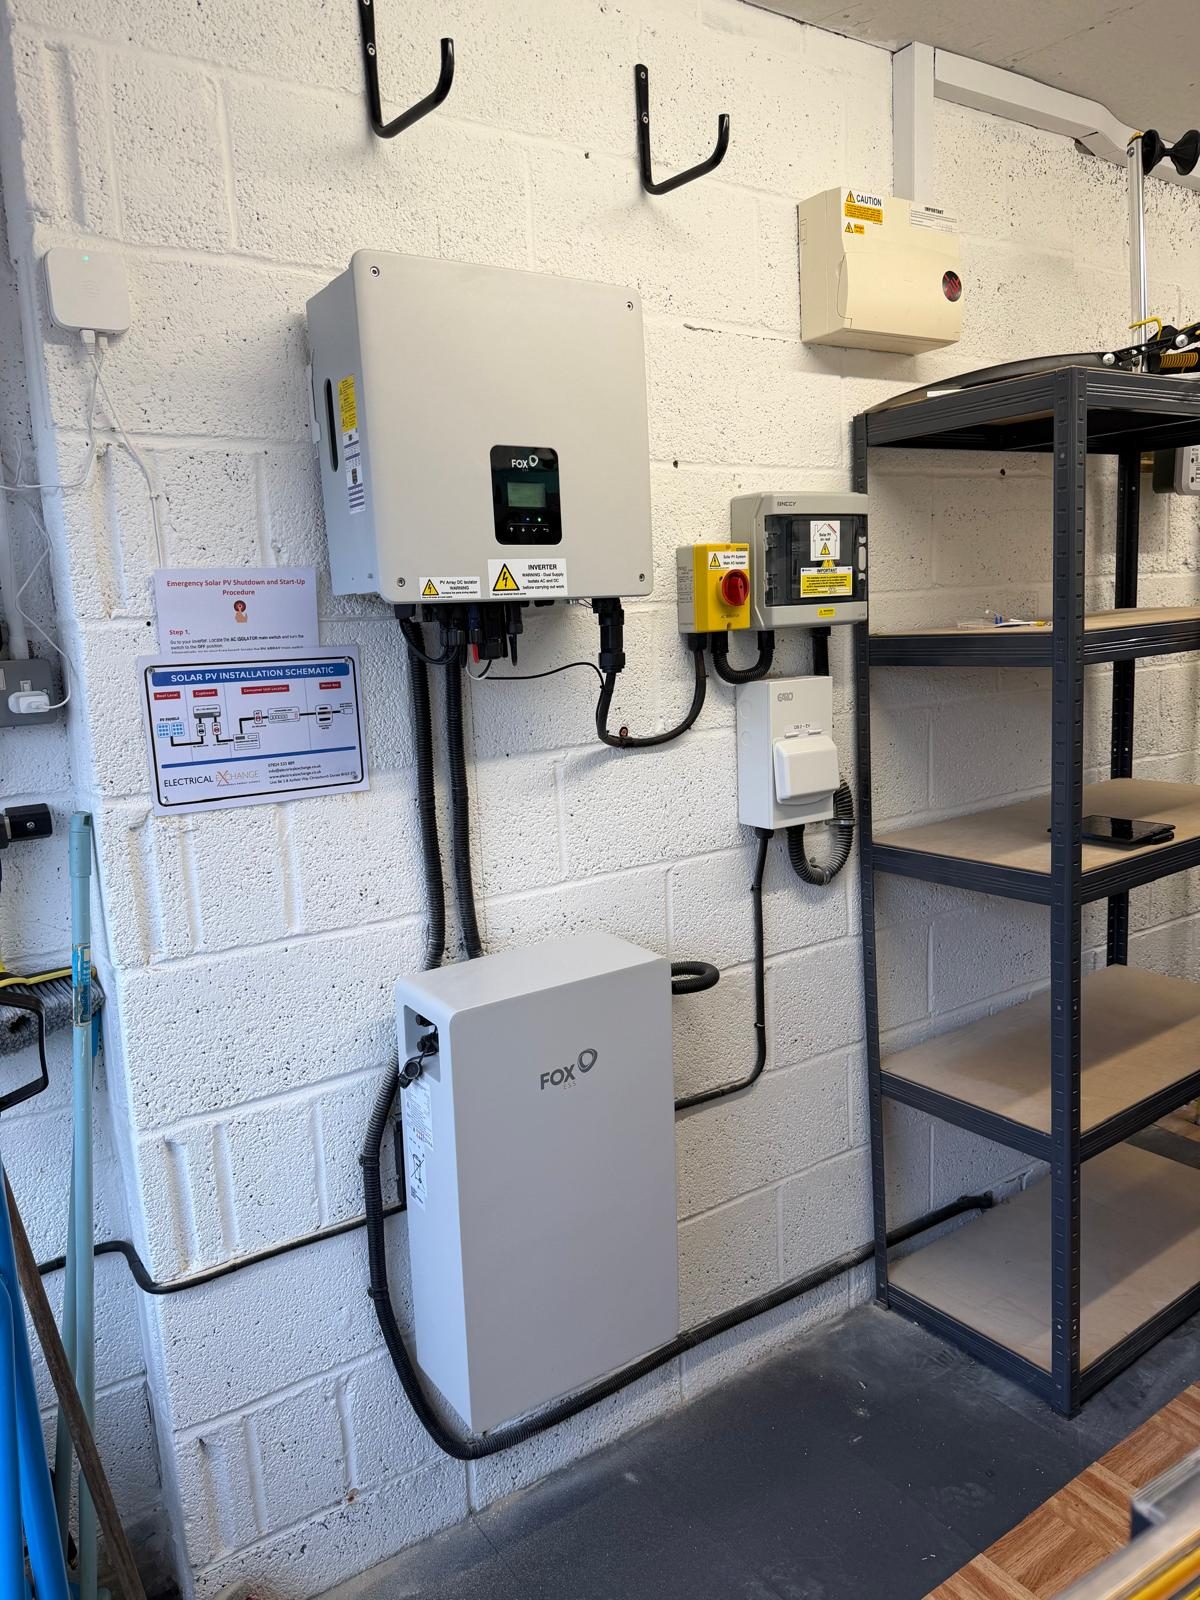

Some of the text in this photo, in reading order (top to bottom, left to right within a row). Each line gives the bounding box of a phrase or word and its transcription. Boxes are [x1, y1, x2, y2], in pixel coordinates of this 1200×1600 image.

[856, 194, 882, 206] CAUTION
[924, 206, 944, 215] IMPORTANT
[511, 459, 528, 468] FOX
[167, 580, 203, 588] Emergency
[279, 578, 306, 586] Start-Up
[170, 665, 335, 683] SOLAR PV INSTALLATION SCHEMATIC
[163, 769, 260, 787] ELECTRICAL EXCHANGE
[540, 1063, 576, 1090] FOX
[563, 1081, 577, 1090] ESS
